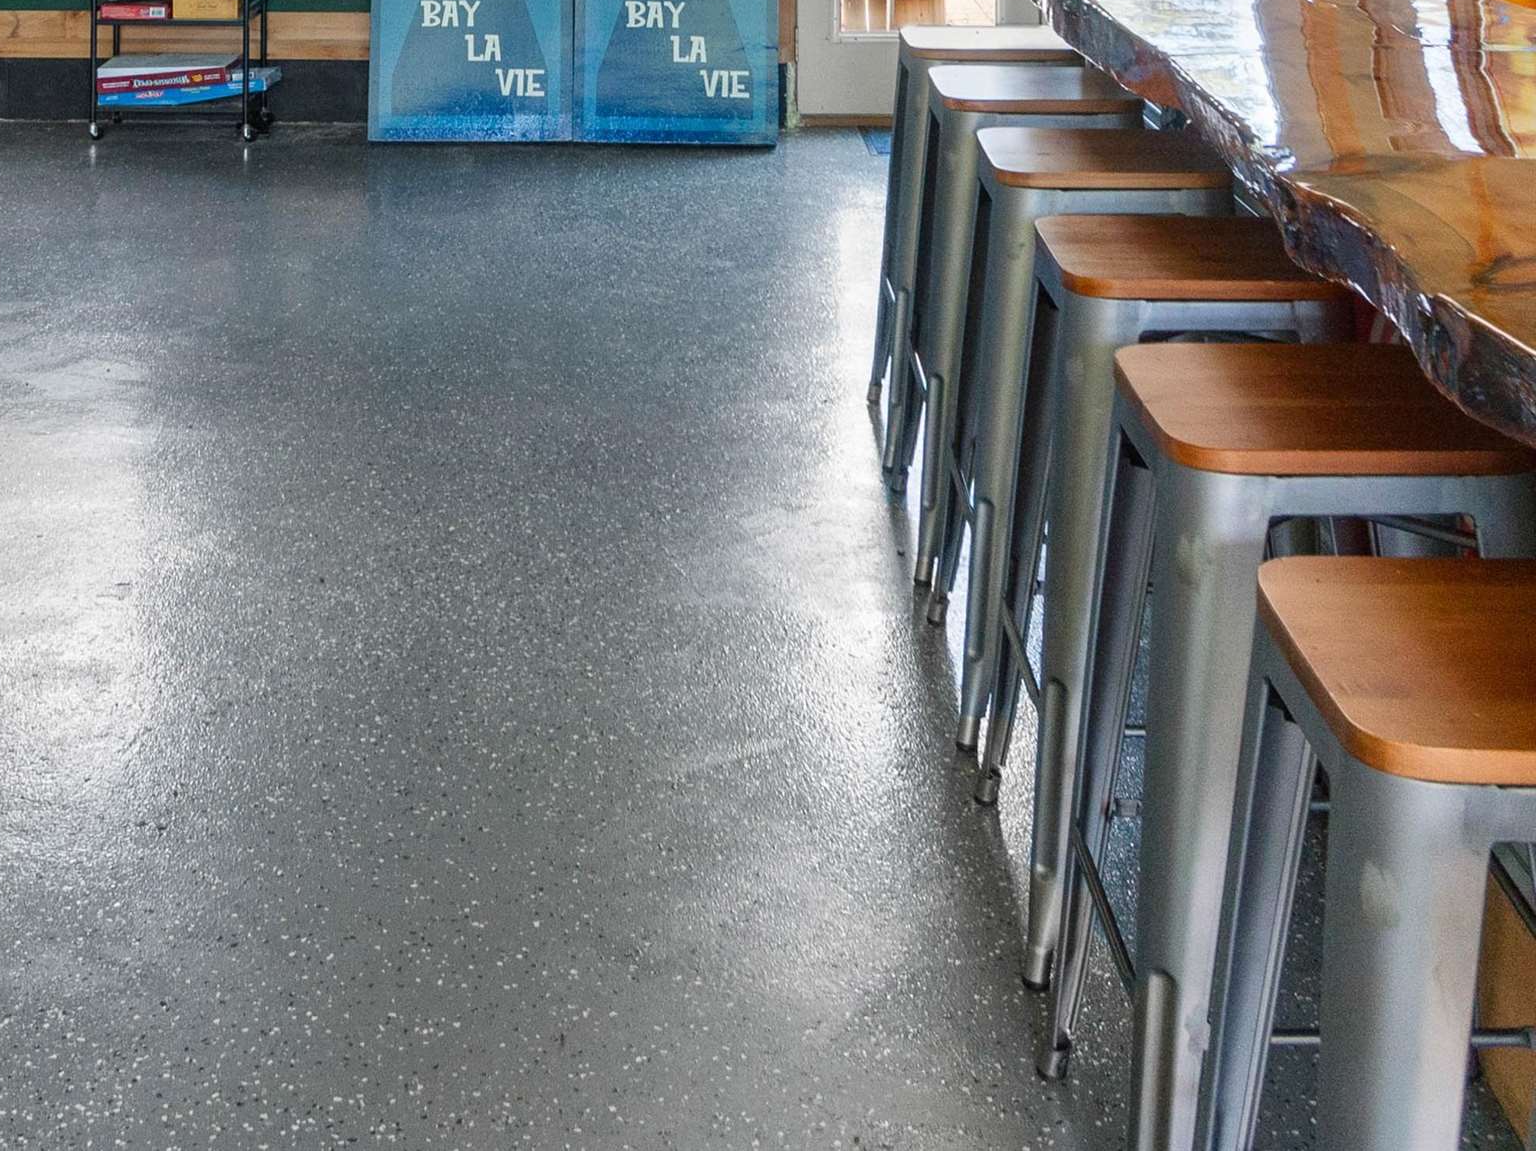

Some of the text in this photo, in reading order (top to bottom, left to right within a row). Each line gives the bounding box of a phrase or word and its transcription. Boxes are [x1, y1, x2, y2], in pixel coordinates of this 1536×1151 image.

[420, 0, 481, 28] BAY
[625, 0, 686, 29] BAY
[465, 34, 502, 62] LA
[670, 35, 708, 64] LA
[495, 68, 546, 98] VIE
[699, 69, 751, 99] VIE
